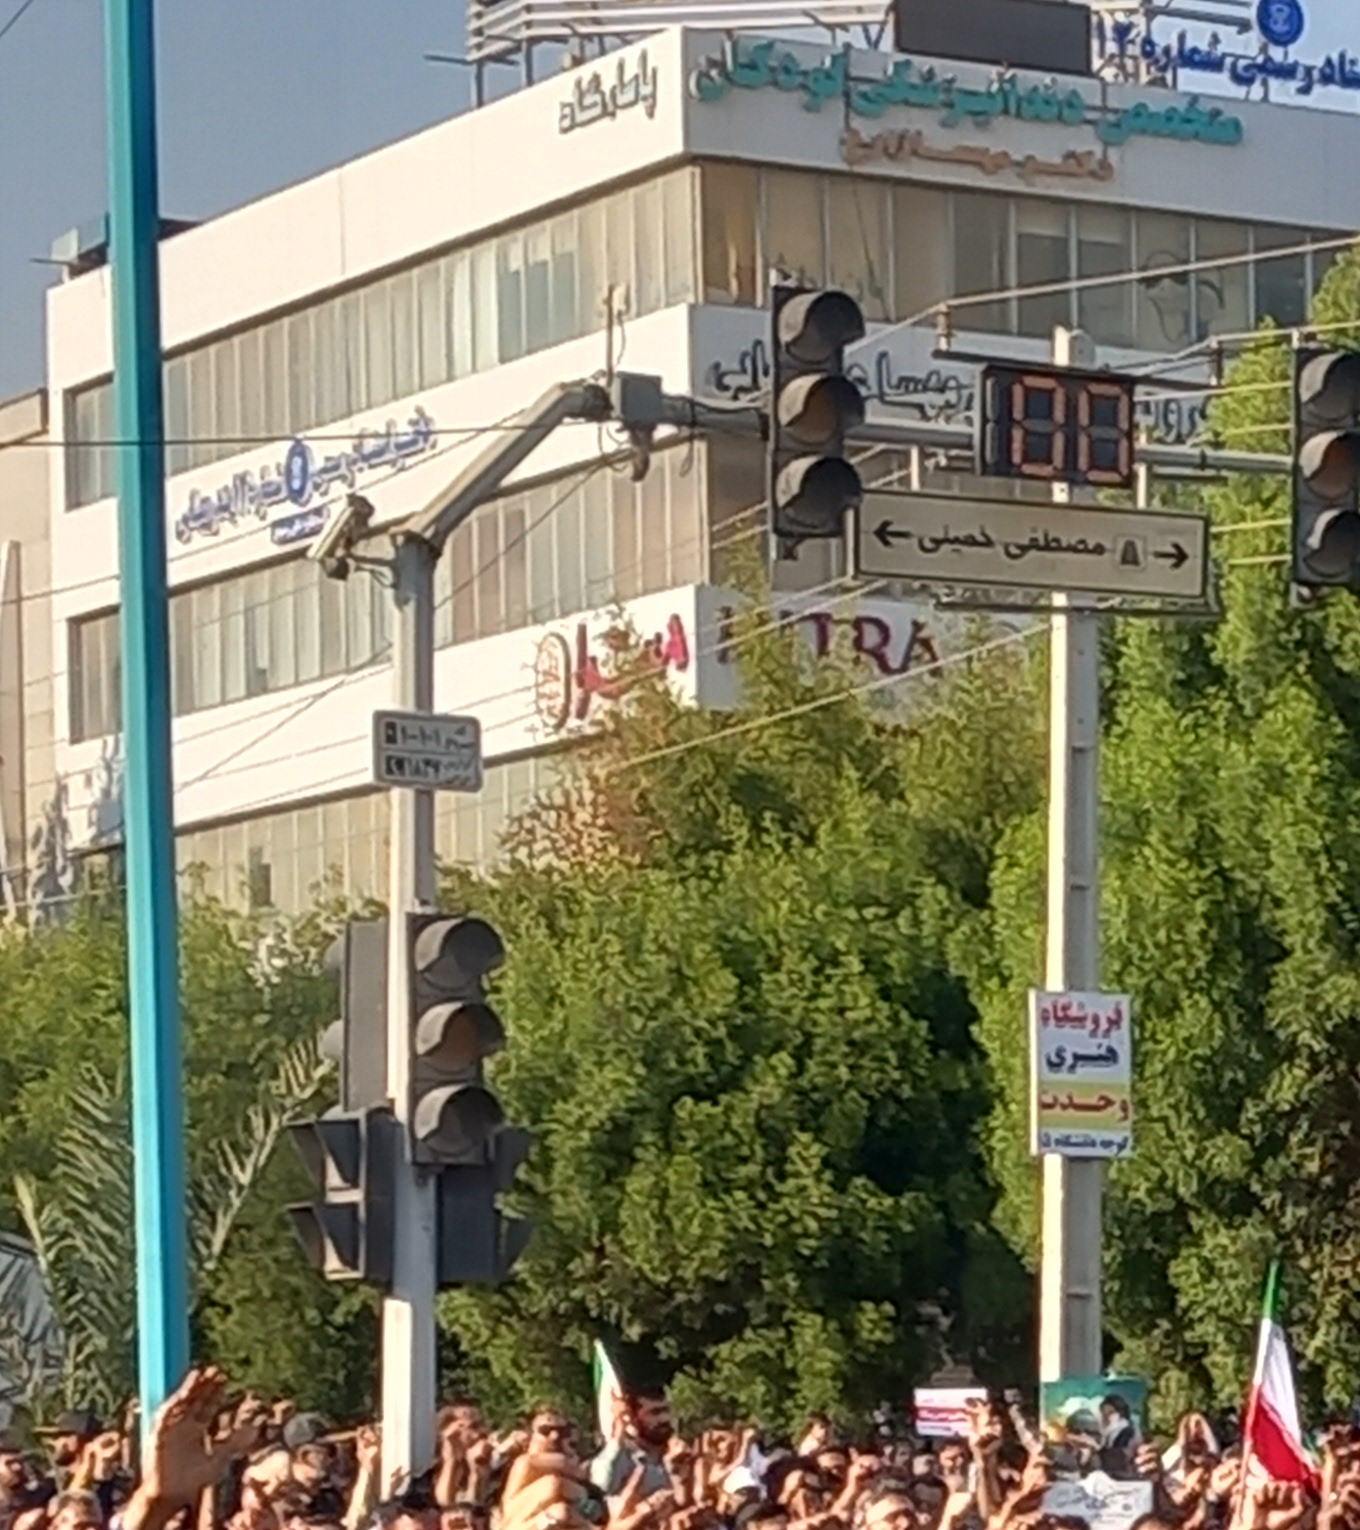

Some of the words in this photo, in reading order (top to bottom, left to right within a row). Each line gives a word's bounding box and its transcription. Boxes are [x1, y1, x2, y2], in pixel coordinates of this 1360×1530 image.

[917, 523, 995, 553] خمینی
[1002, 528, 1107, 560] مصطفی
[1041, 1000, 1123, 1036] فروشگاه
[1040, 1089, 1129, 1122] وحدت
